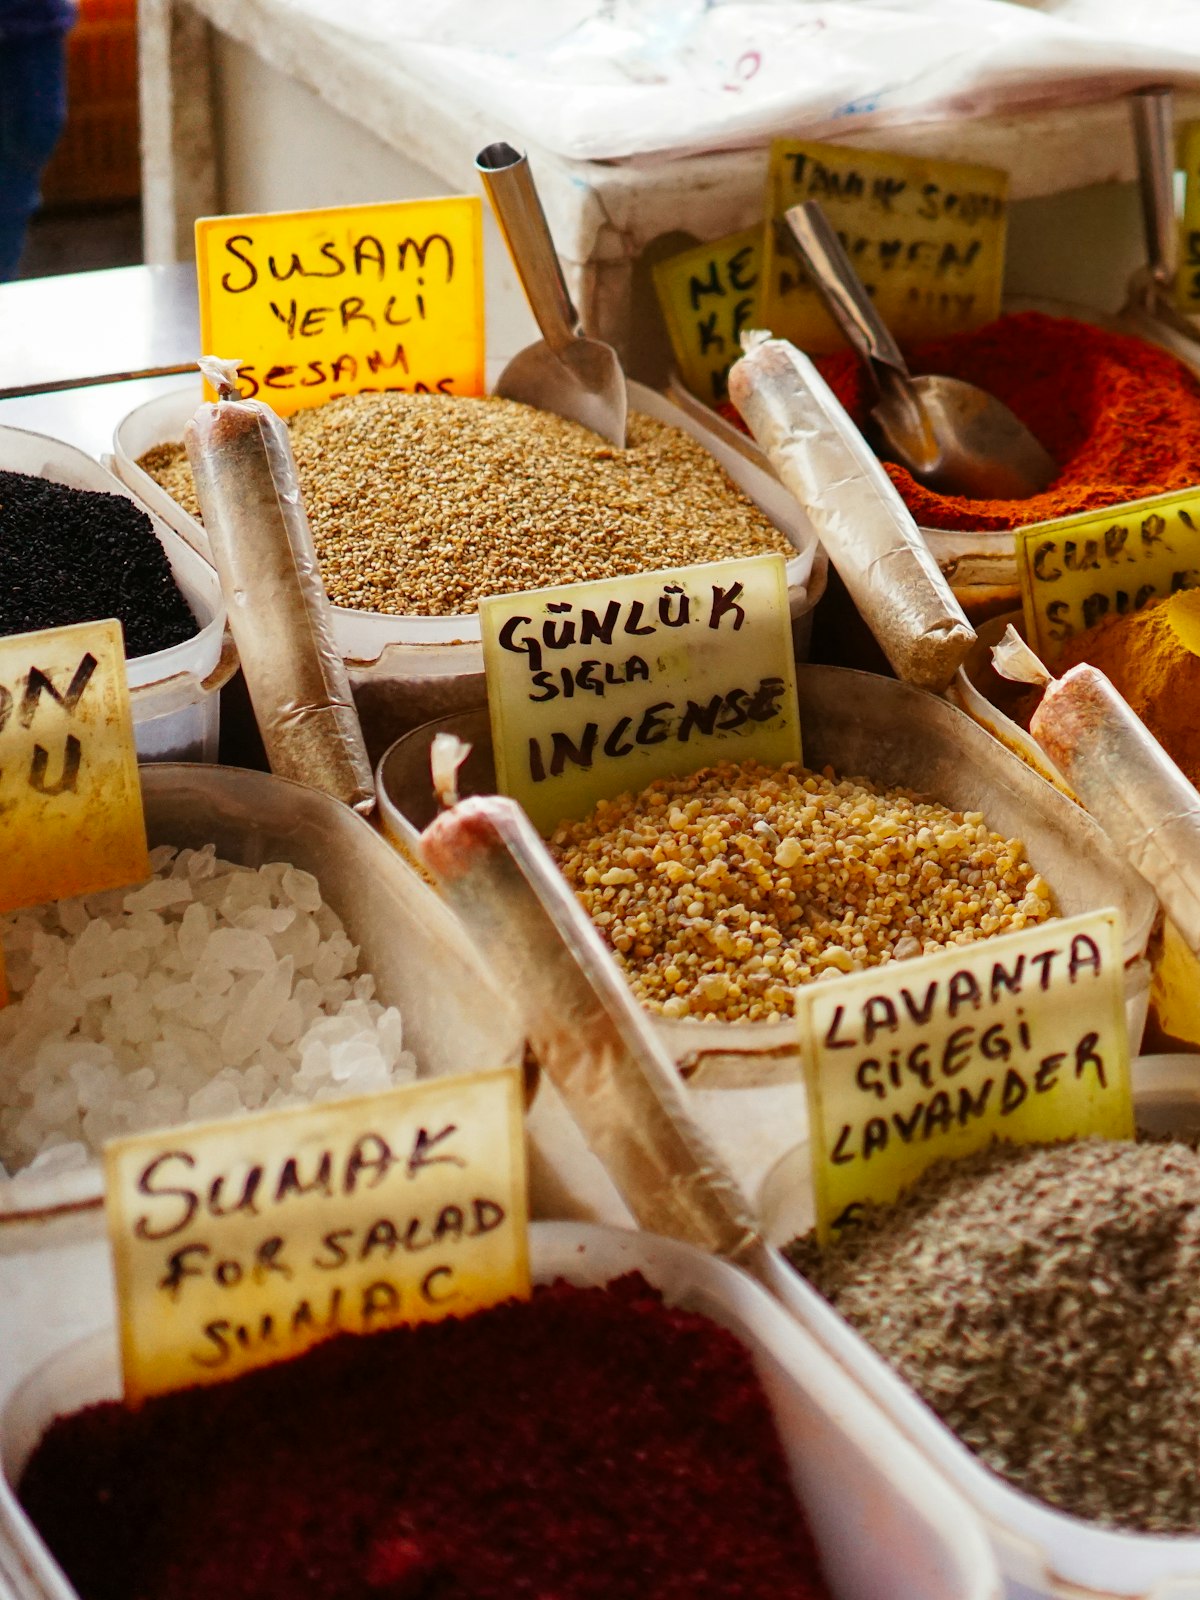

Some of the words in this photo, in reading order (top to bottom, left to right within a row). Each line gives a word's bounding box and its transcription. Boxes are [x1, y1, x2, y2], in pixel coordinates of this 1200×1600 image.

[221, 233, 455, 294] SUSAM
[236, 343, 410, 400] SESAM
[498, 581, 746, 671] GÜNLÜK
[529, 677, 788, 783] INCENSE
[824, 933, 1101, 1050] LAVANTA
[829, 1031, 1108, 1166] LAVANDER
[134, 1123, 468, 1241] SUMAK
[159, 1236, 294, 1302] FOR
[312, 1198, 507, 1270] SALAD
